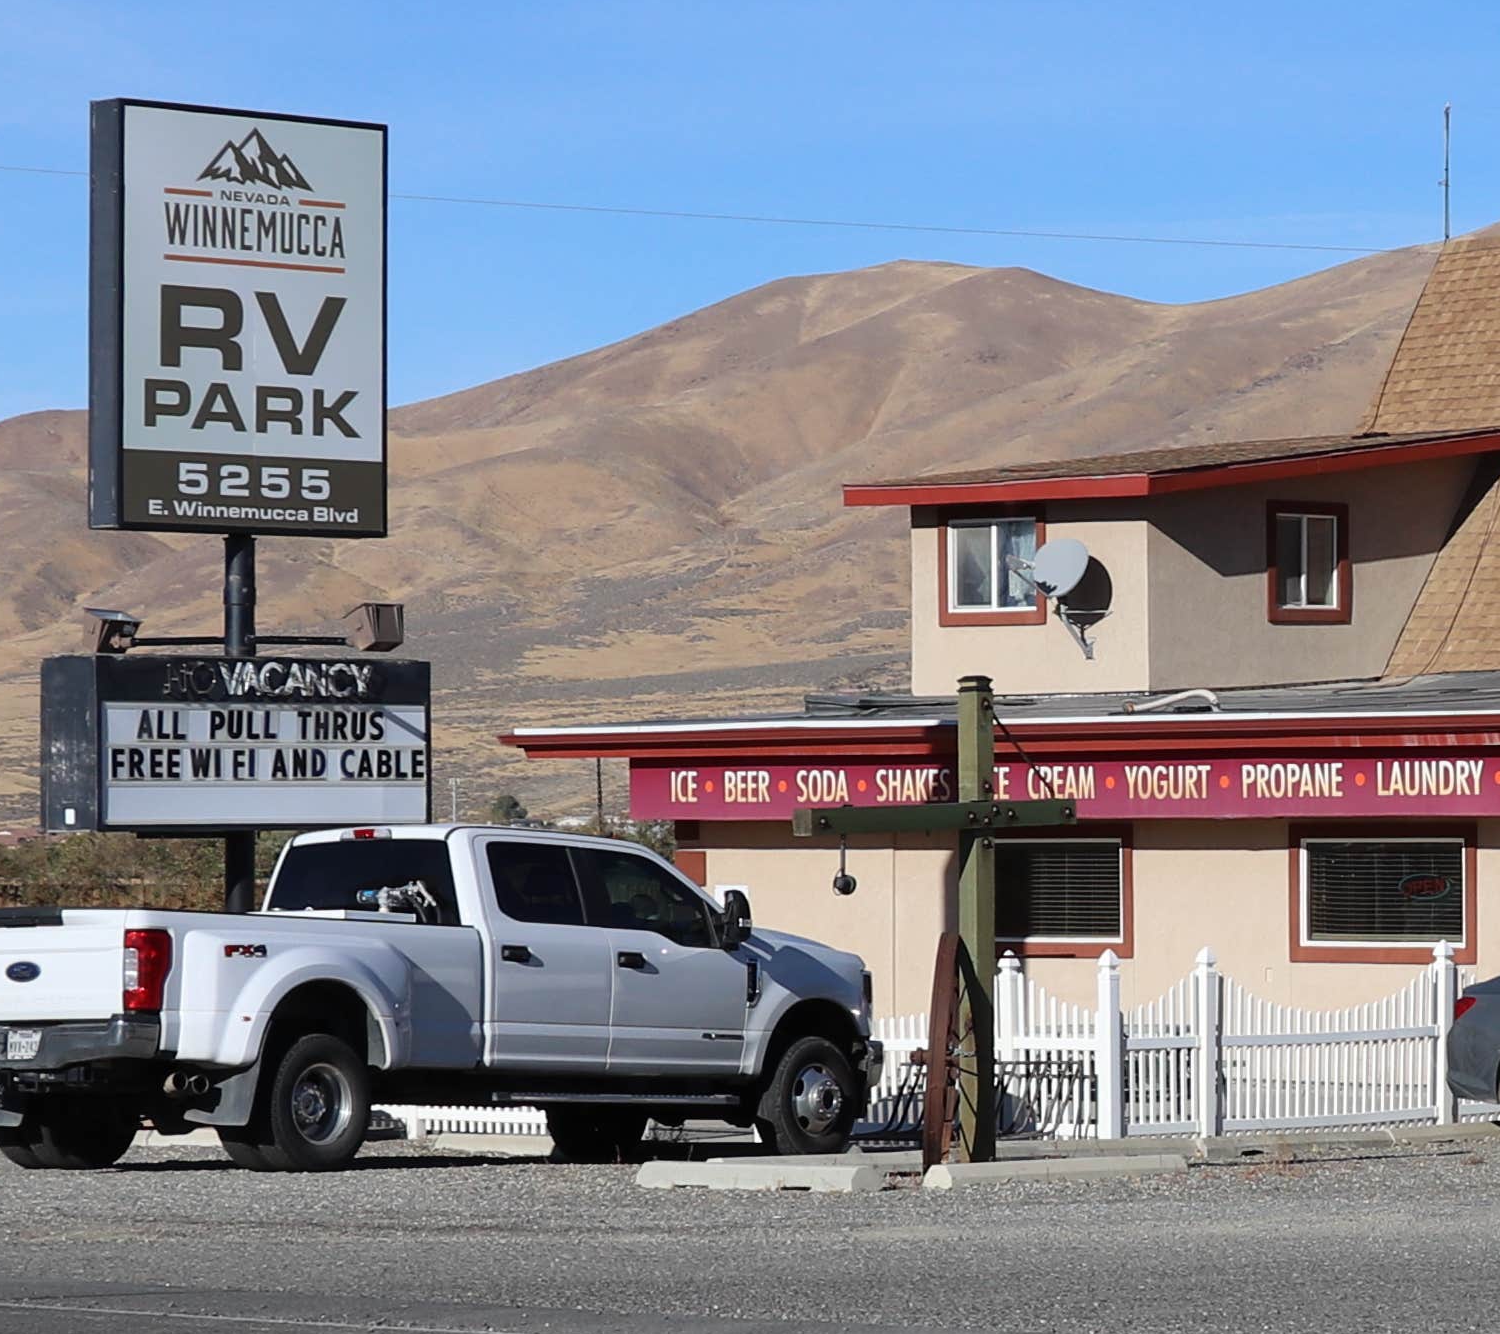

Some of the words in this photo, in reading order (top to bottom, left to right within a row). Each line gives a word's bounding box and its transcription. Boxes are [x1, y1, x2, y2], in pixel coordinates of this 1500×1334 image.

[220, 190, 291, 207] NEVADA
[164, 202, 346, 259] WINNEMUCCA
[160, 284, 347, 376] RV
[144, 378, 362, 439] PARK
[178, 462, 331, 500] 5255
[148, 500, 169, 516] E.
[173, 500, 309, 522] Winnemucca
[313, 507, 359, 524] Blvd
[218, 661, 373, 698] VACANCY
[136, 709, 188, 741] ALL
[209, 709, 278, 741] PULL
[297, 710, 385, 742] THRUS
[111, 748, 181, 779] FREE
[271, 748, 327, 779] AND
[340, 749, 425, 779] CABLE
[669, 770, 699, 803] ICE
[724, 770, 771, 803] BEER
[796, 769, 850, 803] SODA
[875, 768, 950, 803] SHAKES
[1027, 765, 1095, 800] CREAM
[1124, 764, 1211, 801] YOGURT
[1241, 762, 1344, 799] PROPANE
[1375, 758, 1485, 797] LAUNDRY
